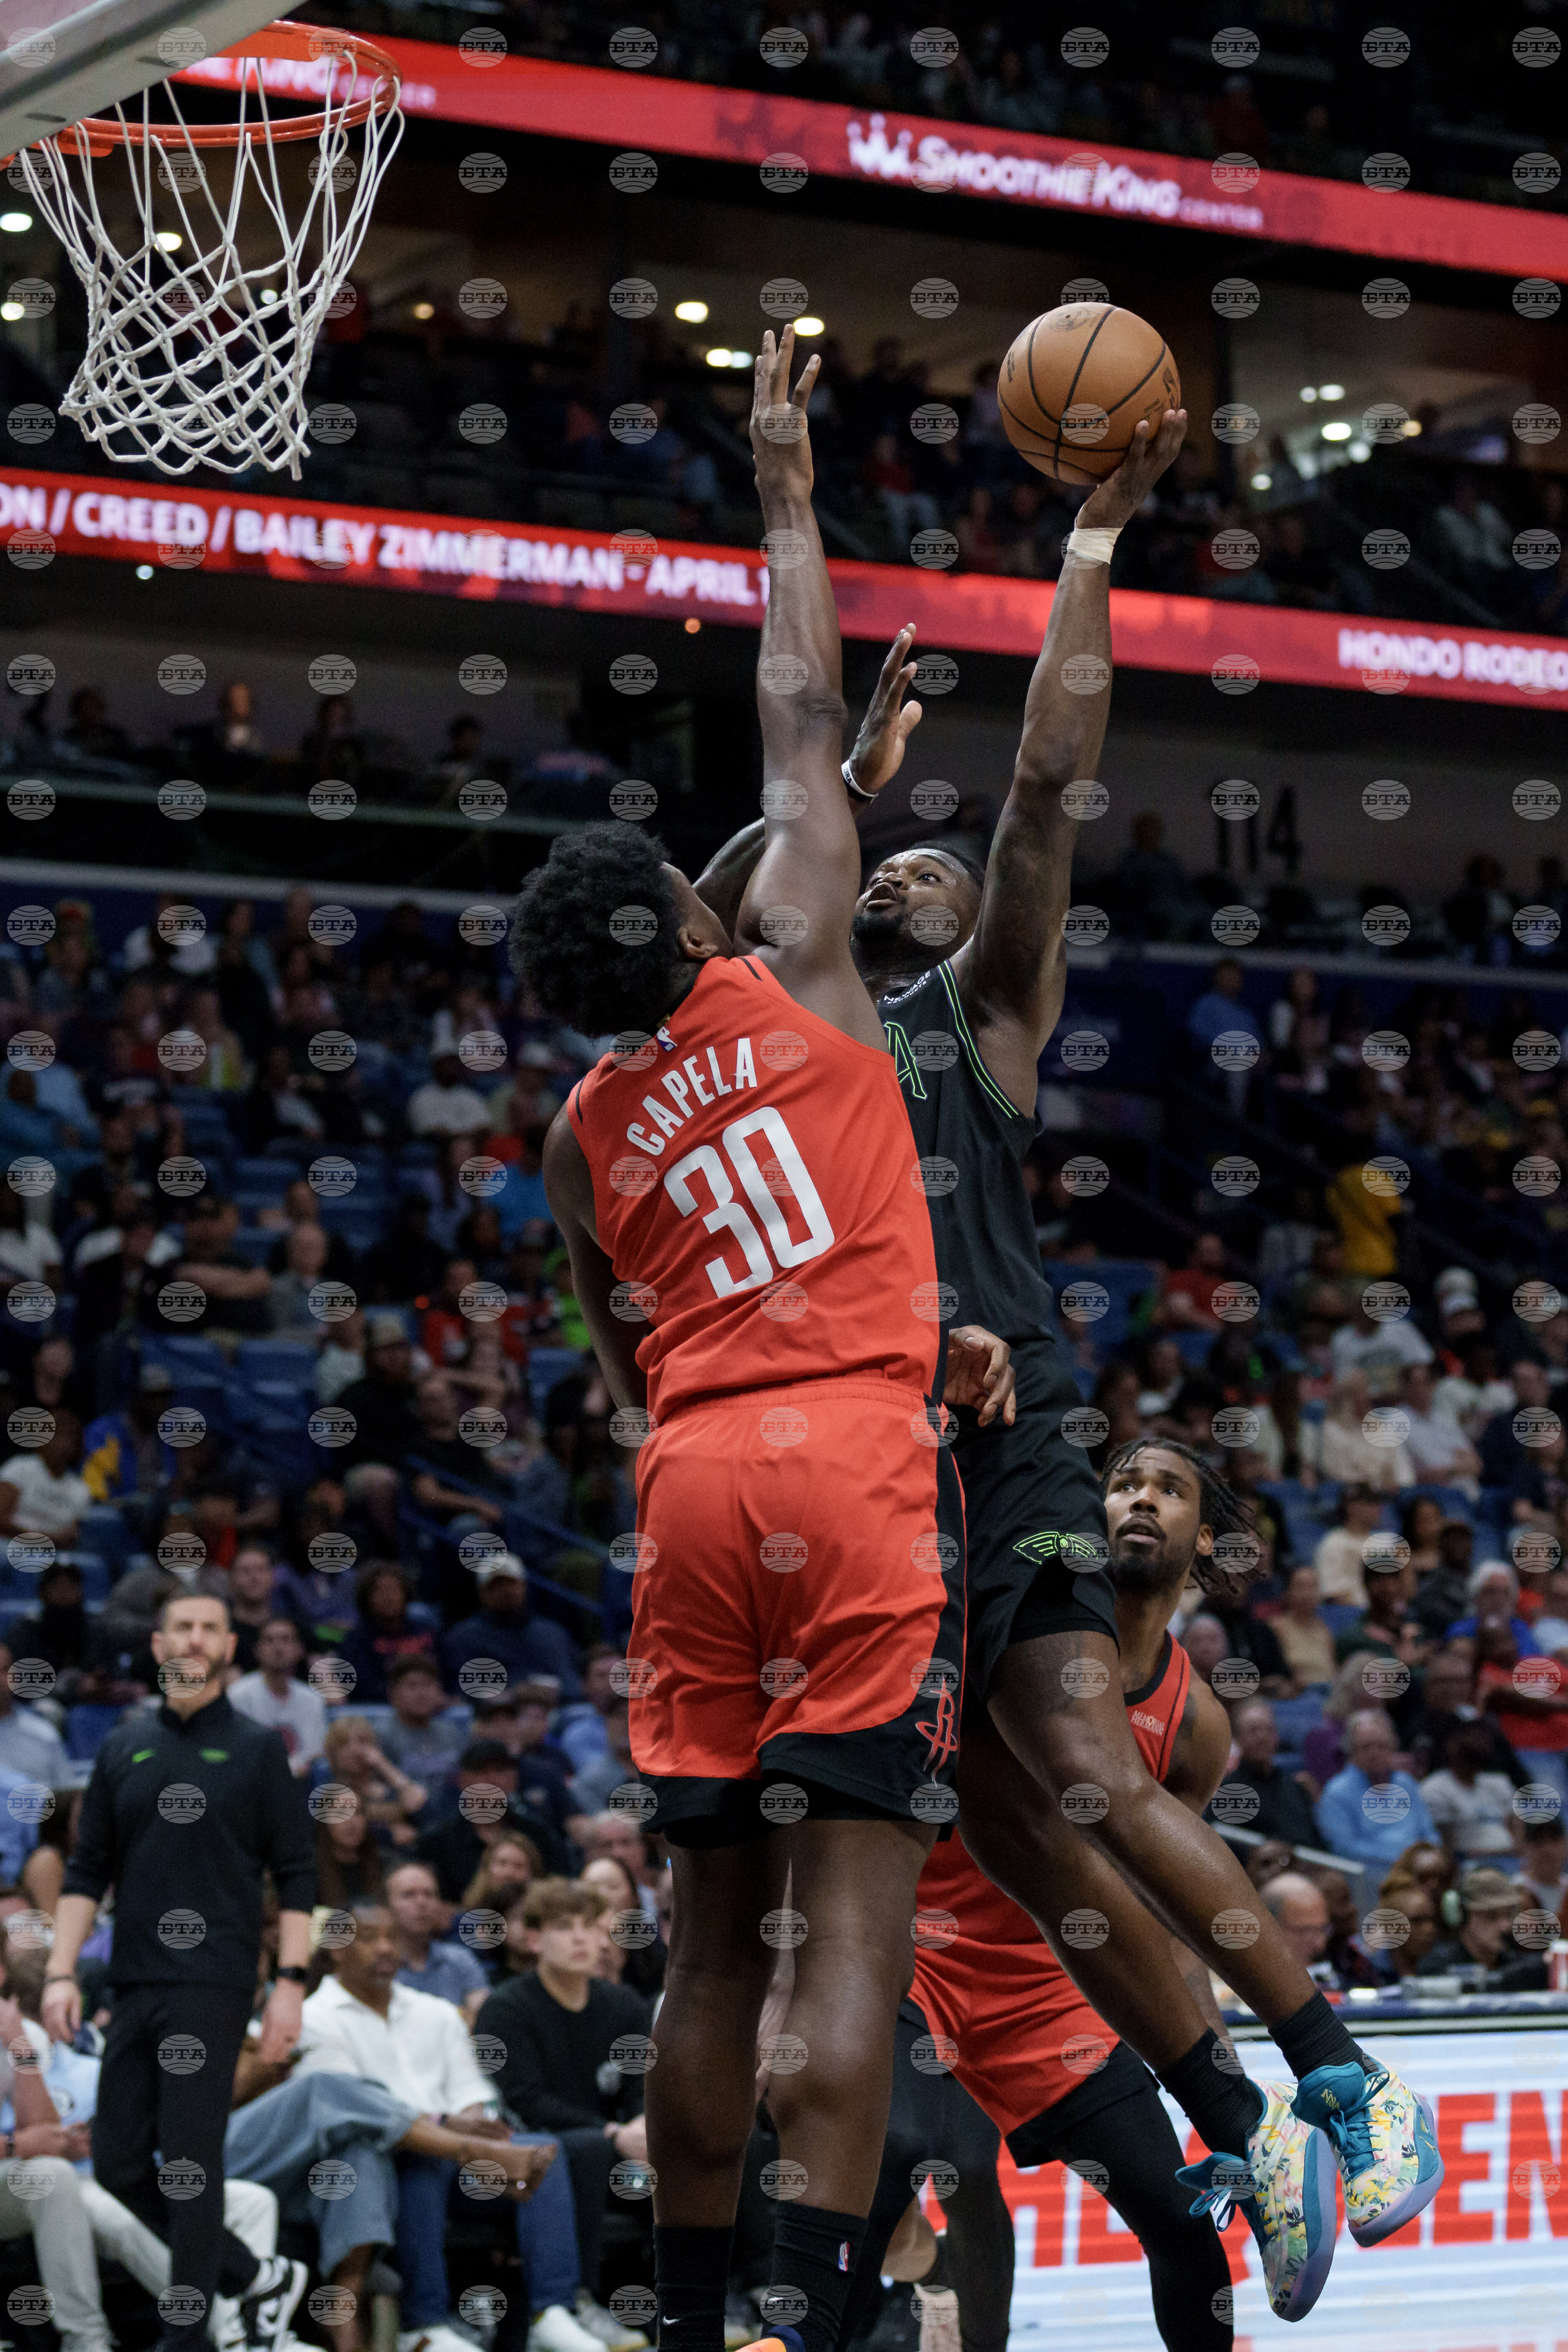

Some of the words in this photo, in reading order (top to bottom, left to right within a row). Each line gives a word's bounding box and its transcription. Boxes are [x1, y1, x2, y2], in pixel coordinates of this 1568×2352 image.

[72, 492, 209, 547] CREED
[234, 508, 376, 564] BAILEY
[645, 554, 757, 606] APRIL
[1338, 627, 1461, 680] HONDO
[626, 1037, 758, 1156] CAPELA
[663, 1106, 835, 1299] 30
